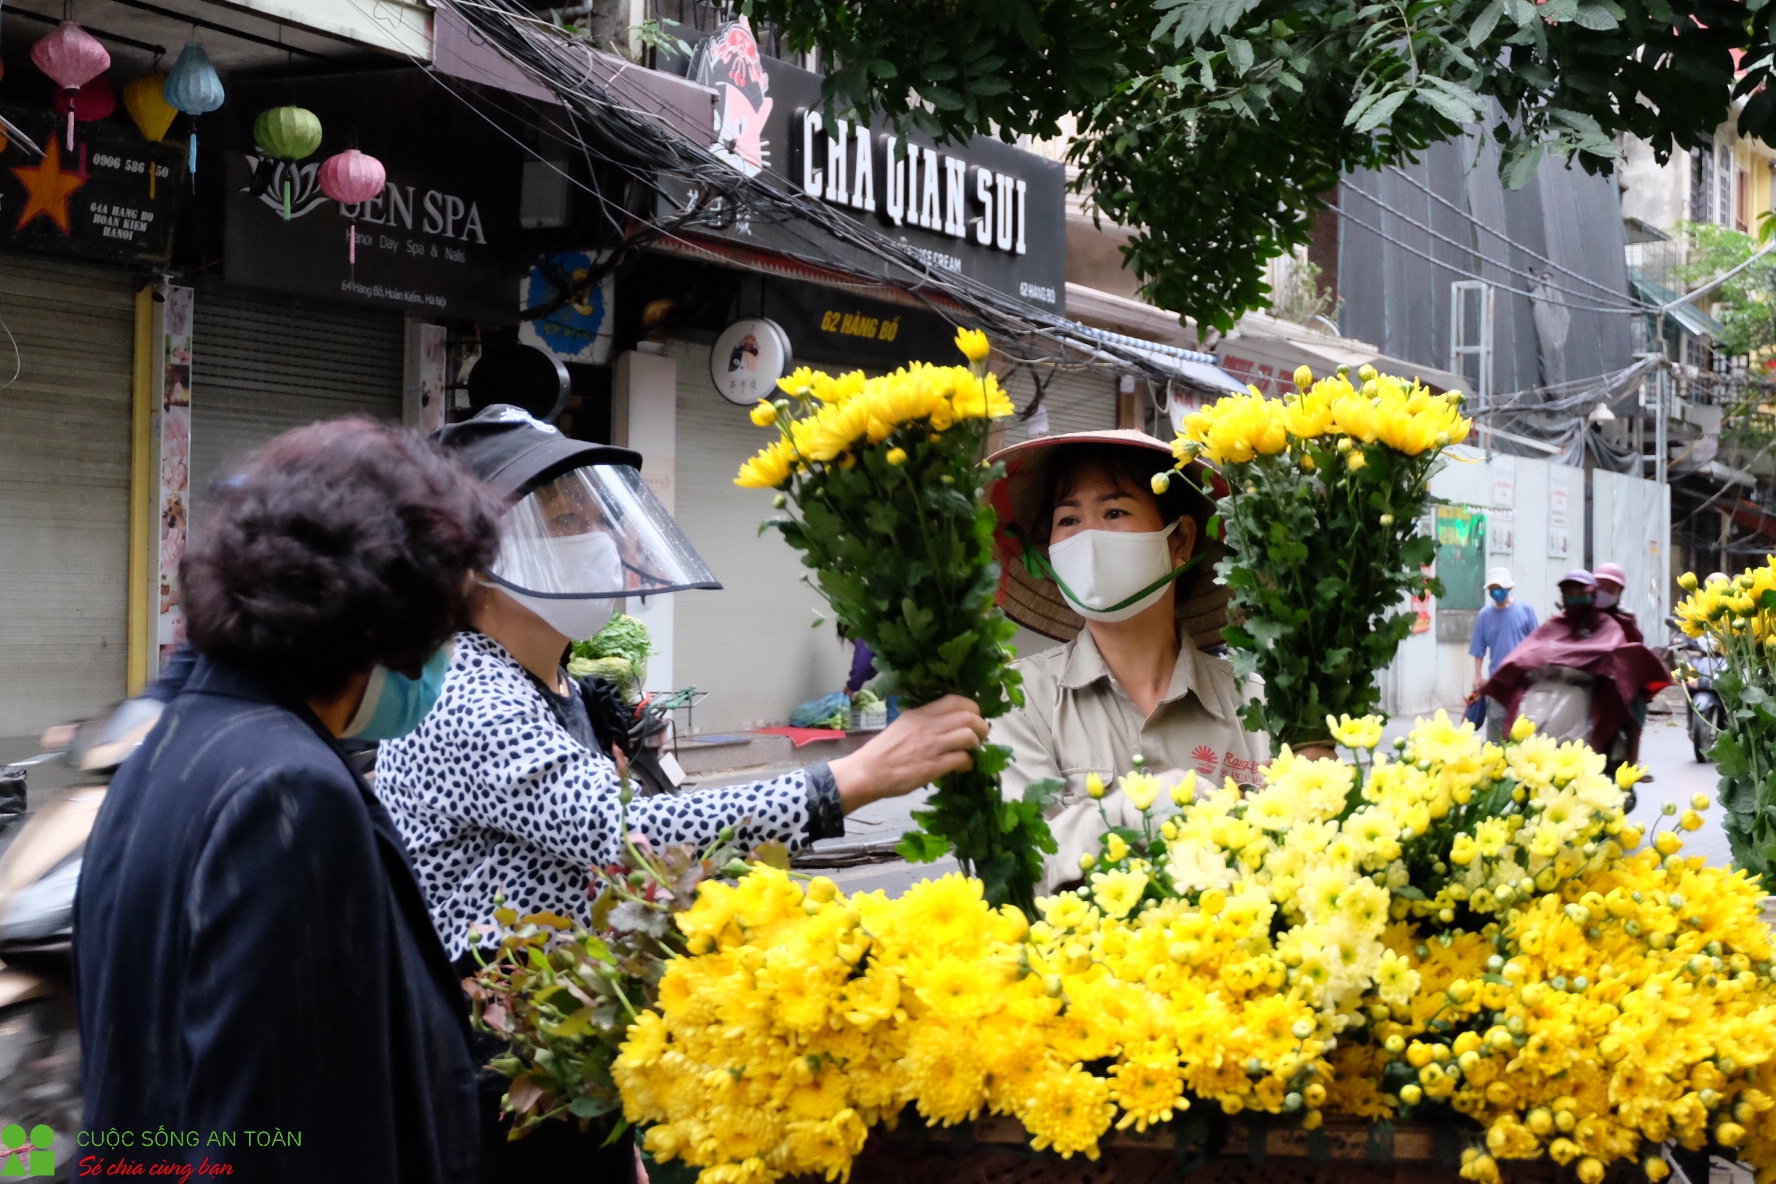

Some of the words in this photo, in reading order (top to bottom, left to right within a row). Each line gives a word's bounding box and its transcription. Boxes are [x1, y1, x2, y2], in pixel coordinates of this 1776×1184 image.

[93, 153, 121, 169] 0906
[125, 159, 145, 174] 586
[149, 162, 169, 178] 50
[803, 110, 876, 212] CHA
[887, 136, 967, 238] QIAN
[976, 167, 1027, 255] SUI
[90, 202, 108, 215] 64A
[111, 205, 138, 219] HANG
[140, 211, 154, 223] BO
[93, 213, 120, 228] HOAN
[123, 218, 148, 232] KIEM
[422, 189, 487, 245] SPA
[103, 226, 133, 241] HANOI
[380, 235, 398, 254] Day
[406, 240, 425, 257] Spa
[430, 244, 439, 258] &
[445, 247, 465, 263] Nails
[821, 310, 841, 332] 62
